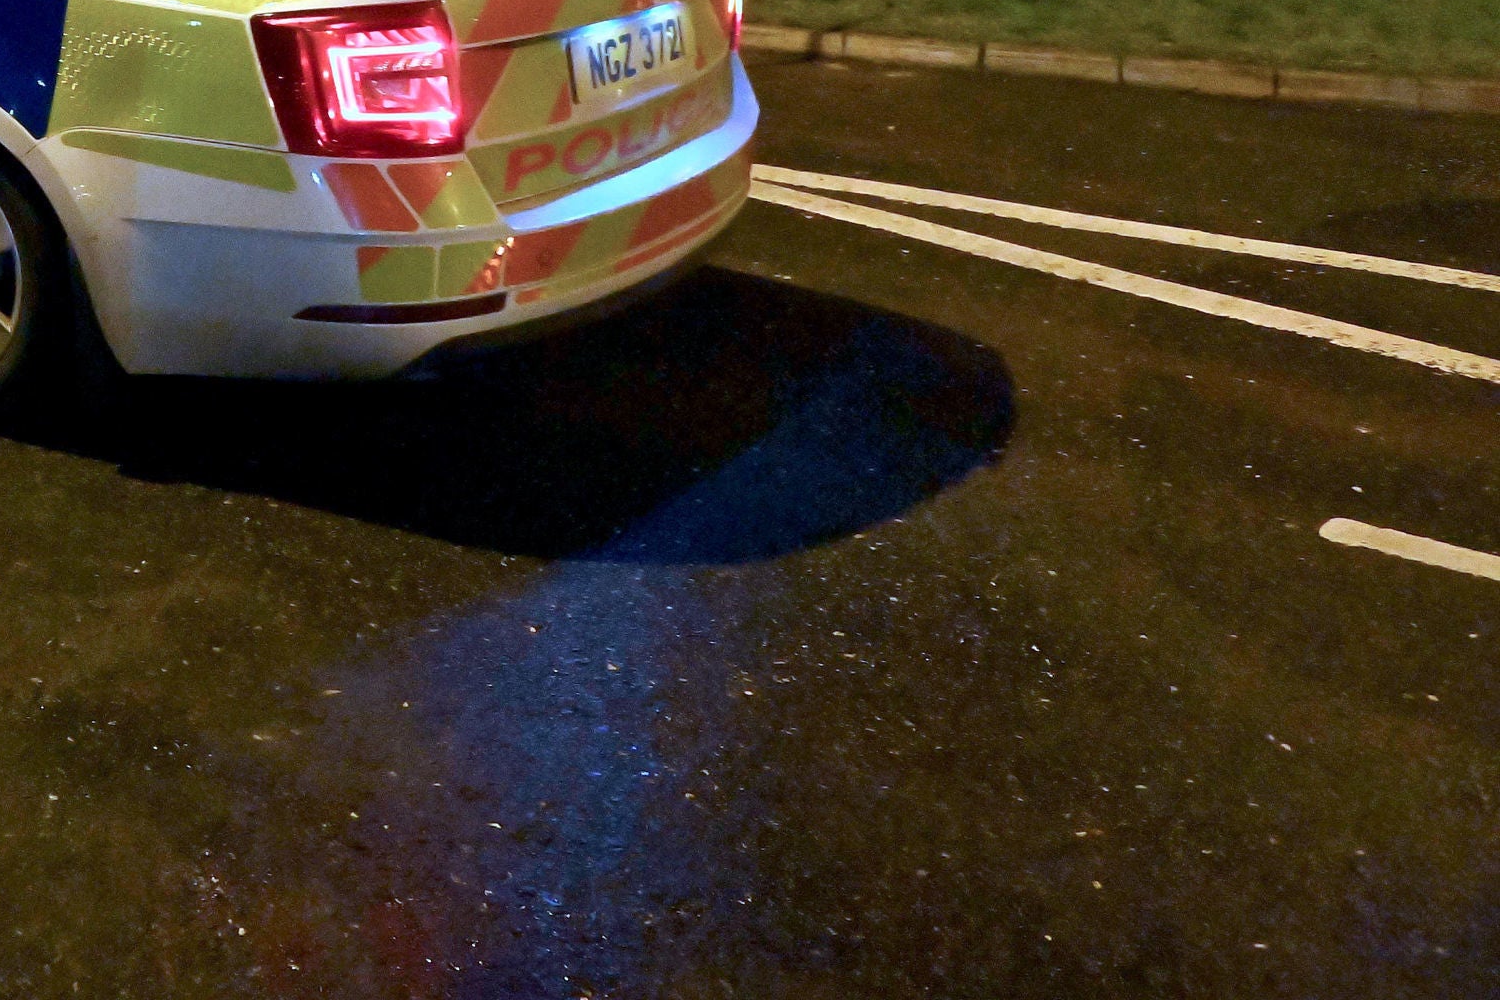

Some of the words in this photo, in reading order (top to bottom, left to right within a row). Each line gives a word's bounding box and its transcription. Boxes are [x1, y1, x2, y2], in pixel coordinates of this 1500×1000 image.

[588, 33, 636, 89] NGZ
[639, 16, 685, 69] 3721
[503, 88, 712, 194] POLIC
